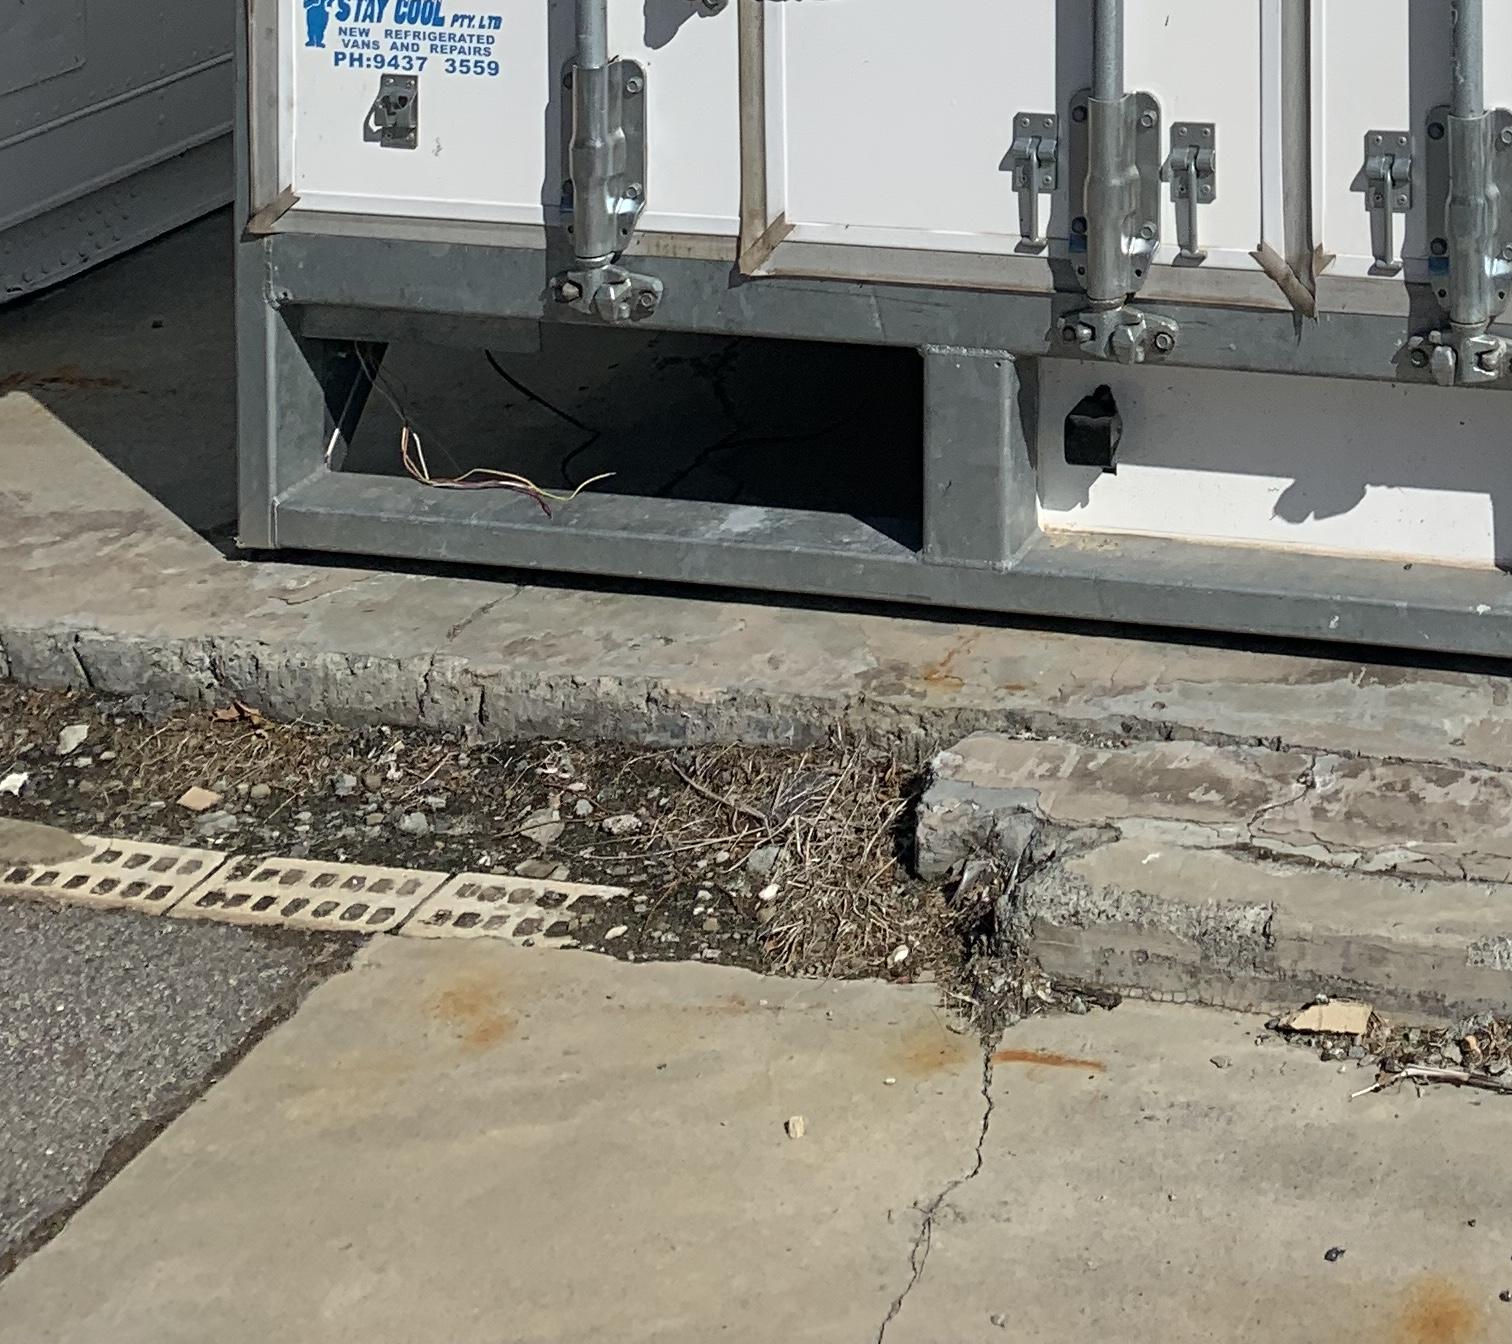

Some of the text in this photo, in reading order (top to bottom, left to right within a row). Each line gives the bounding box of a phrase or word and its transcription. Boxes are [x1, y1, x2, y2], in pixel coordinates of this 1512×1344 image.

[478, 15, 503, 30] LTD
[338, 26, 495, 45] NEW REFRIGERATED
[342, 38, 492, 58] VANS AND REPAIRS
[333, 50, 500, 77] PH:9437 3559
